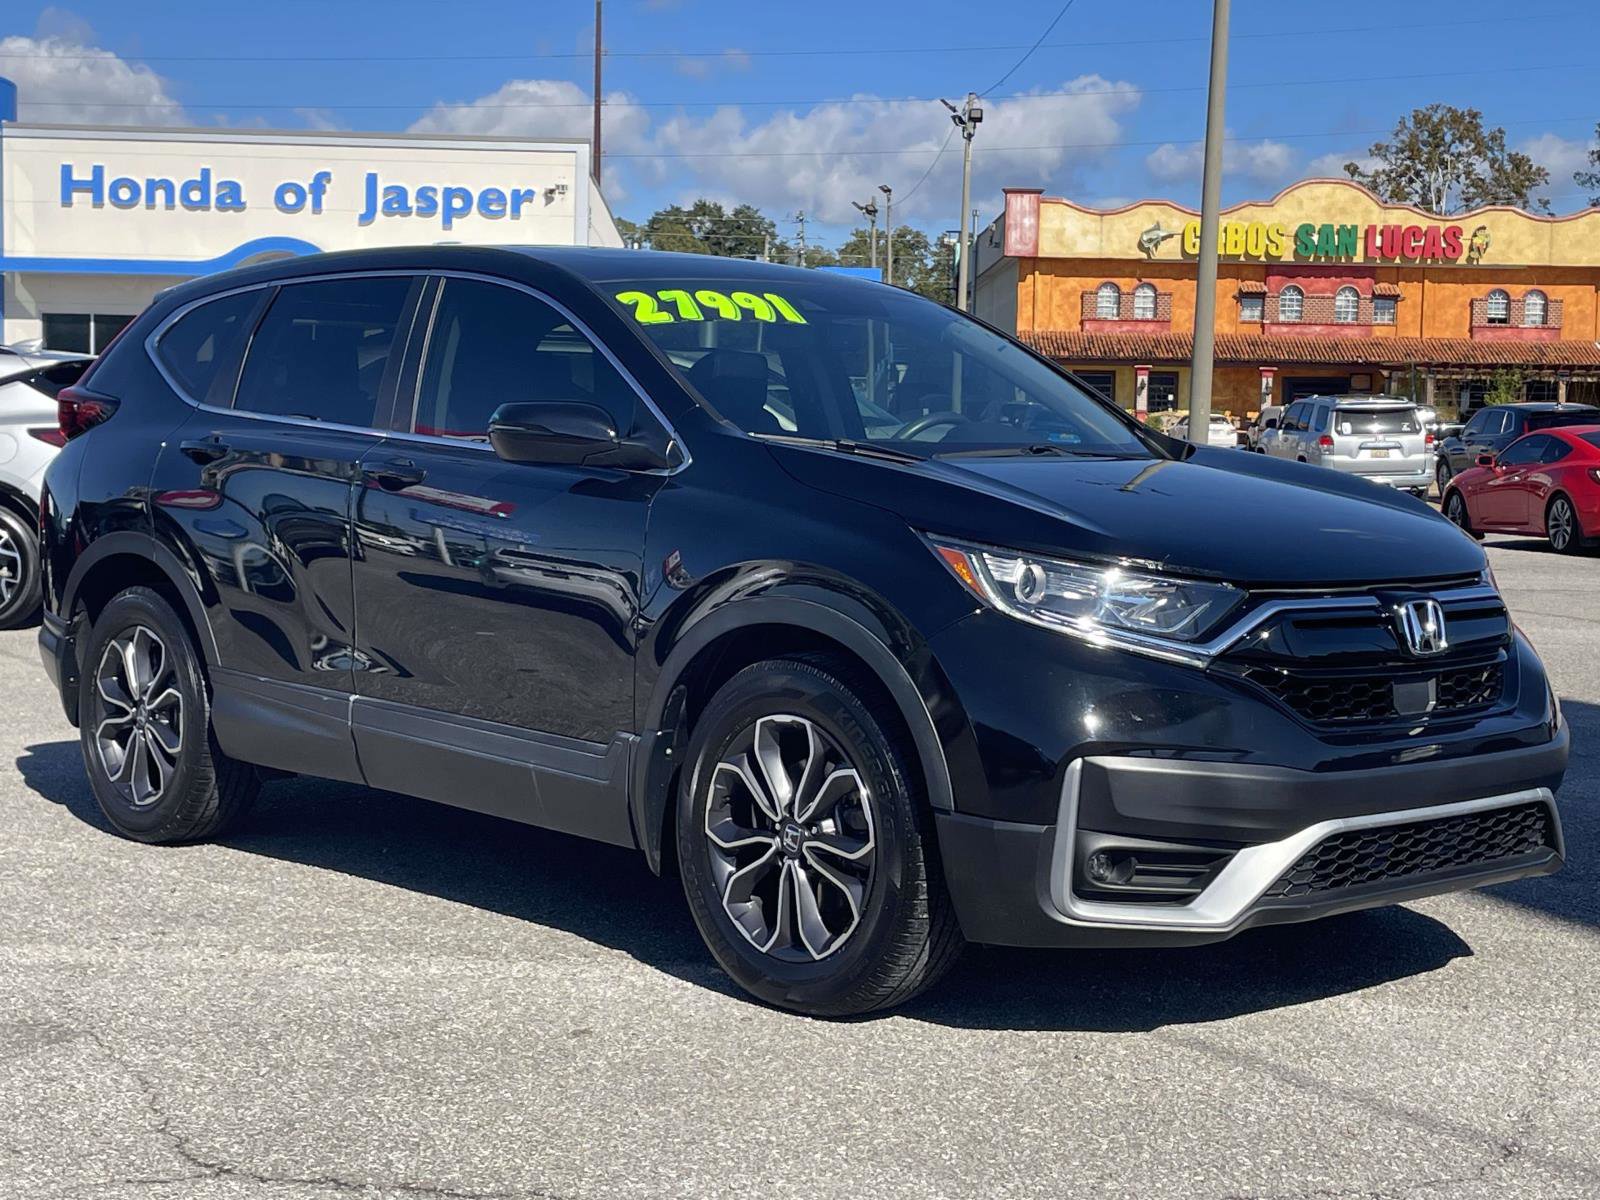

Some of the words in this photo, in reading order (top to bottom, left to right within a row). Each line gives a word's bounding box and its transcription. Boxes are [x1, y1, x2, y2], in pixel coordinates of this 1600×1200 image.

[60, 163, 246, 211] Honda
[274, 171, 332, 213] of
[358, 172, 536, 229] Jasper
[1295, 223, 1358, 257] SAN
[1366, 225, 1463, 259] LUCAS
[615, 290, 808, 325] 27991
